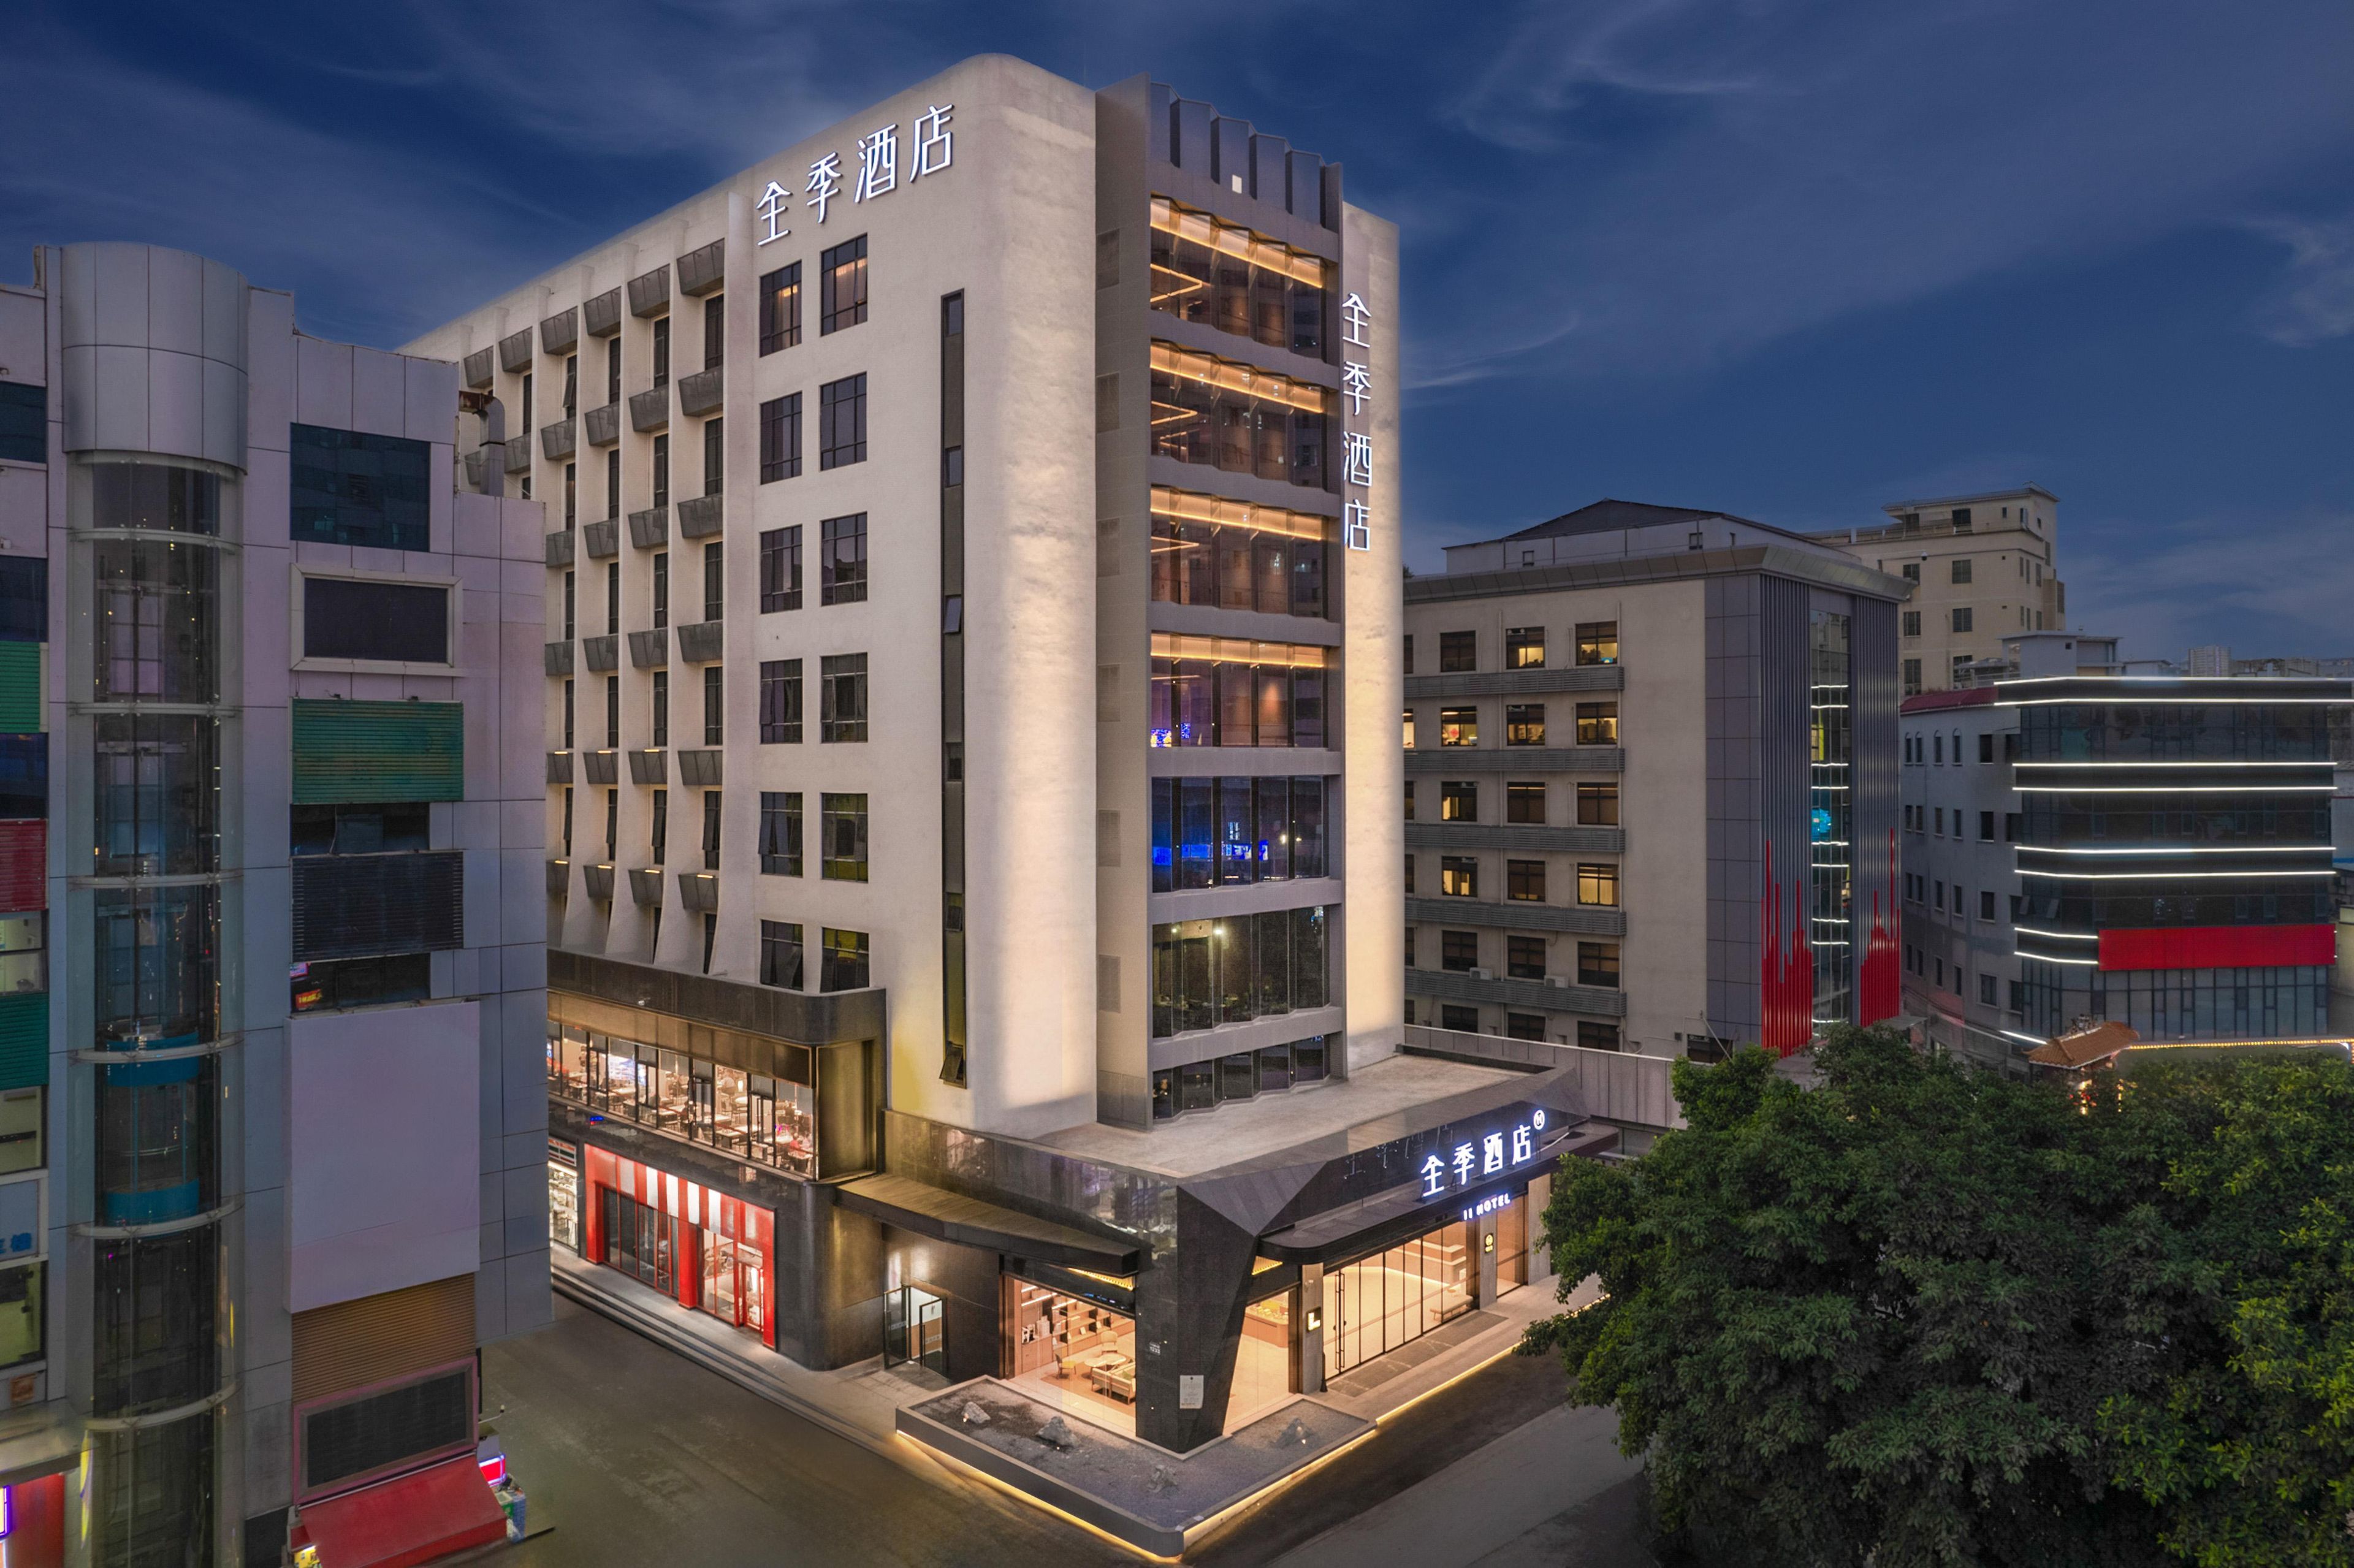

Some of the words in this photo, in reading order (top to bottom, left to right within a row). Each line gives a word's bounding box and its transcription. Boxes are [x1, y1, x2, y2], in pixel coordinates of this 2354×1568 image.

[756, 104, 954, 246] 全季酒店
[1343, 292, 1372, 551] 全季酒店
[1420, 1124, 1531, 1198] 全季酒店
[1476, 1193, 1510, 1216] HOTEL
